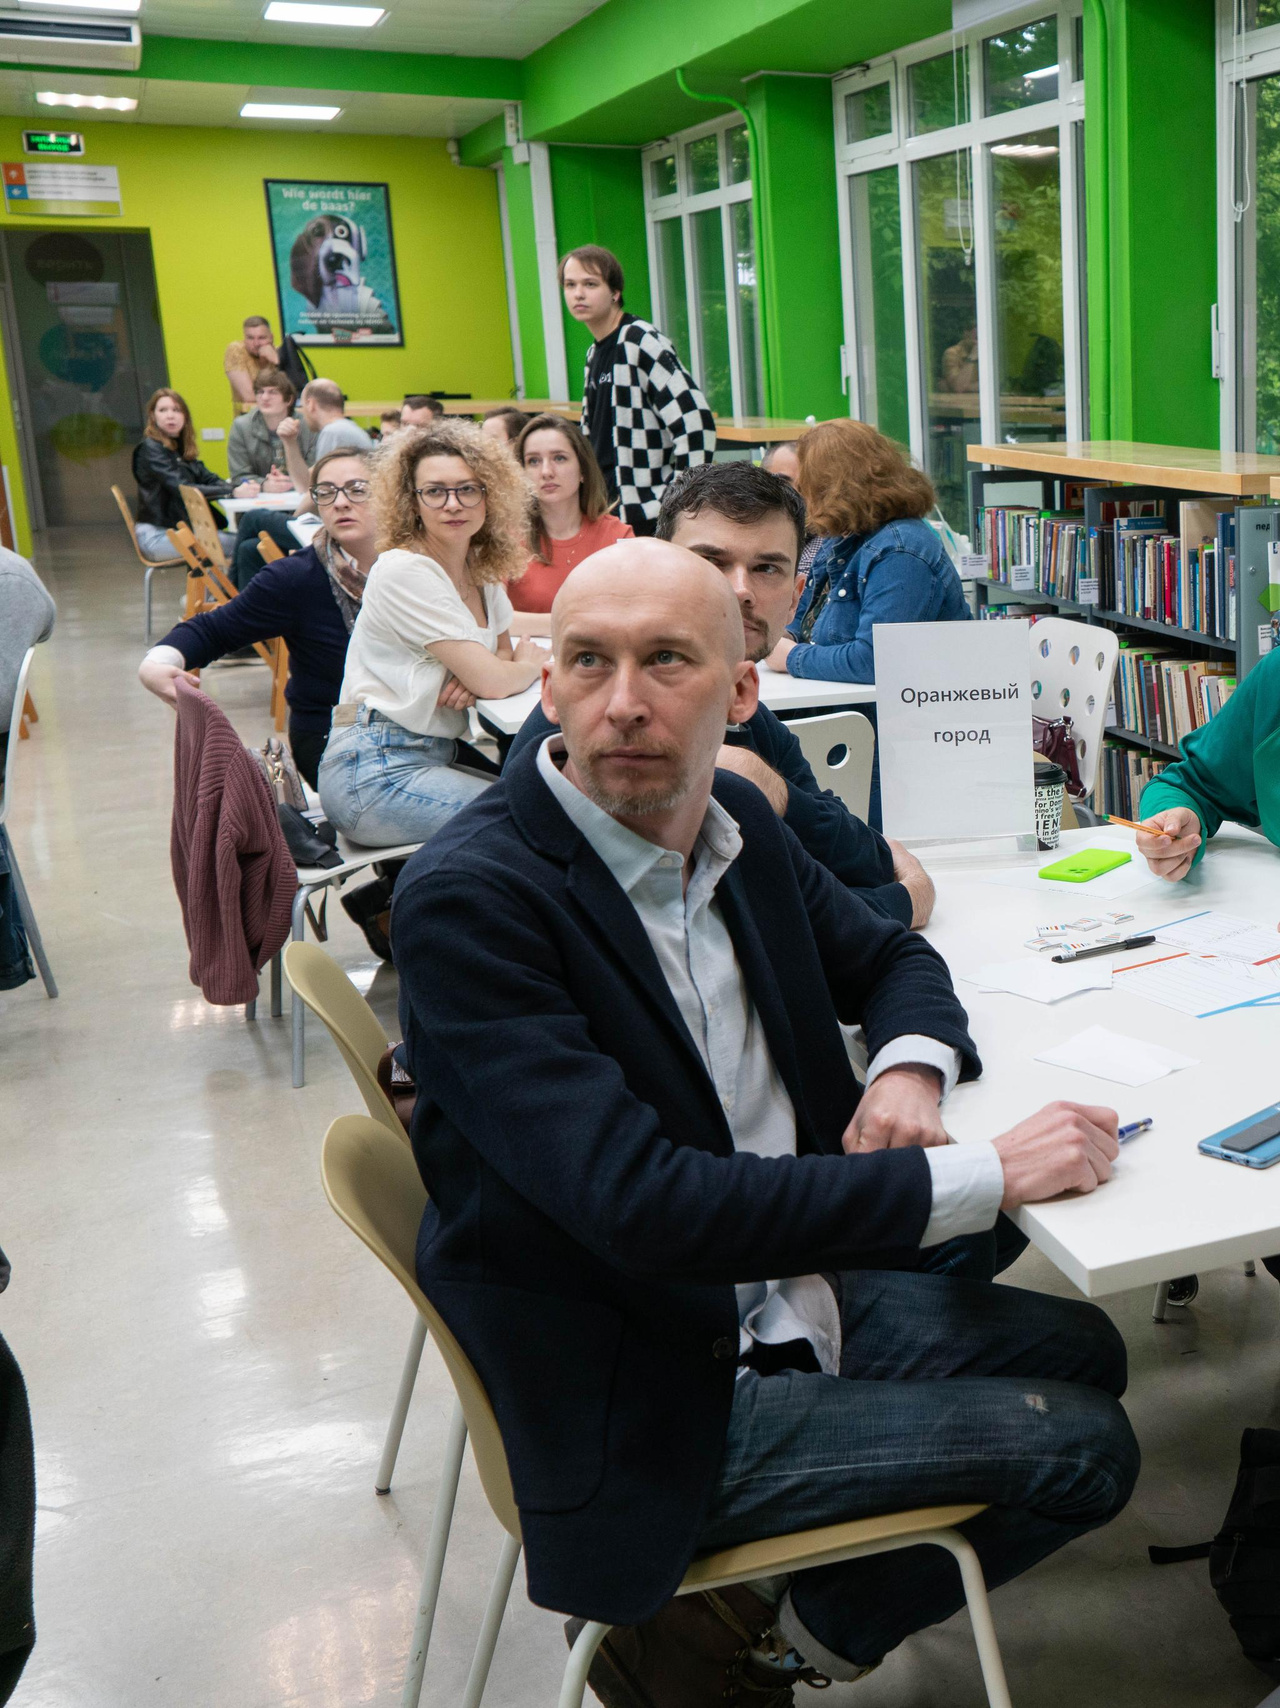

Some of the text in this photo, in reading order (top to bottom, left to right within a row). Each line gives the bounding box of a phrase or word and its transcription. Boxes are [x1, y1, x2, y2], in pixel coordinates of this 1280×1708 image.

[282, 188, 305, 199] Wie
[347, 190, 371, 200] hier
[302, 201, 356, 211] de baas?
[901, 683, 1019, 706] Оранжевый
[934, 729, 991, 746] город
[1047, 788, 1060, 796] the
